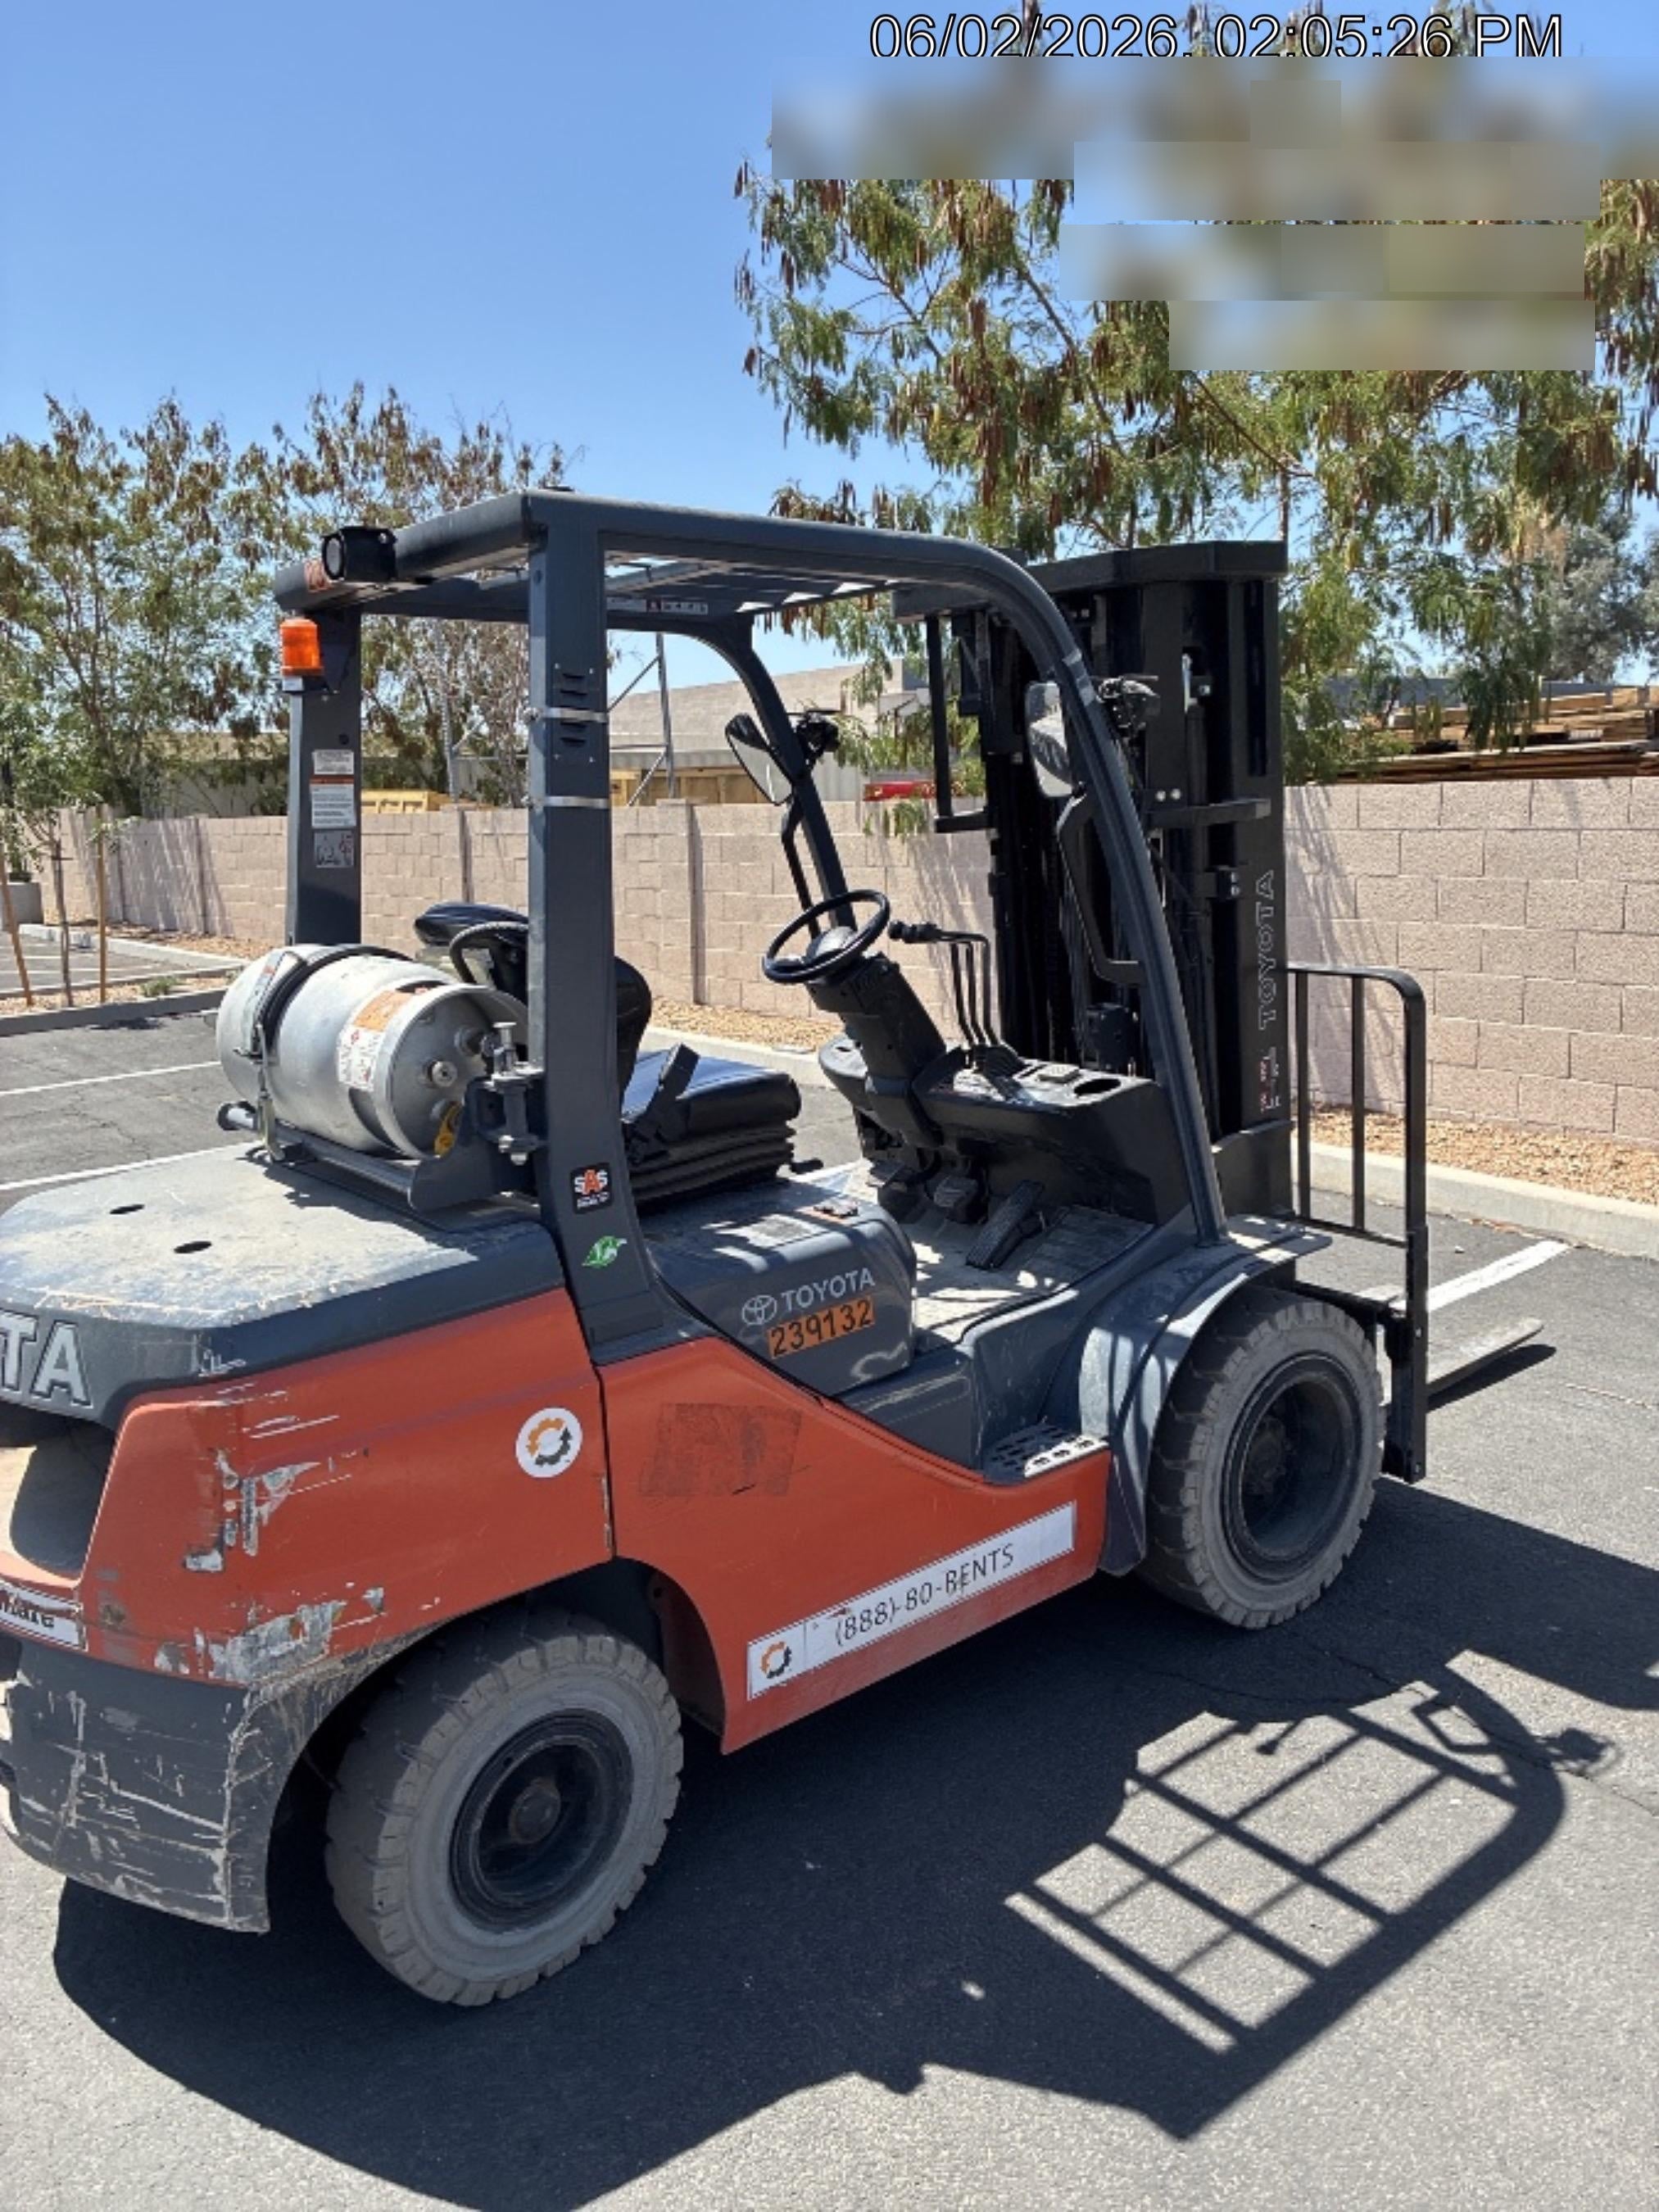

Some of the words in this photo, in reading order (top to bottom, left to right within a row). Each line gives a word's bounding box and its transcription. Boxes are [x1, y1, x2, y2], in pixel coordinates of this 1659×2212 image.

[1255, 868, 1276, 1031] TOYOTA
[781, 1267, 876, 1311] TOYOTA
[770, 1299, 873, 1358] 239132
